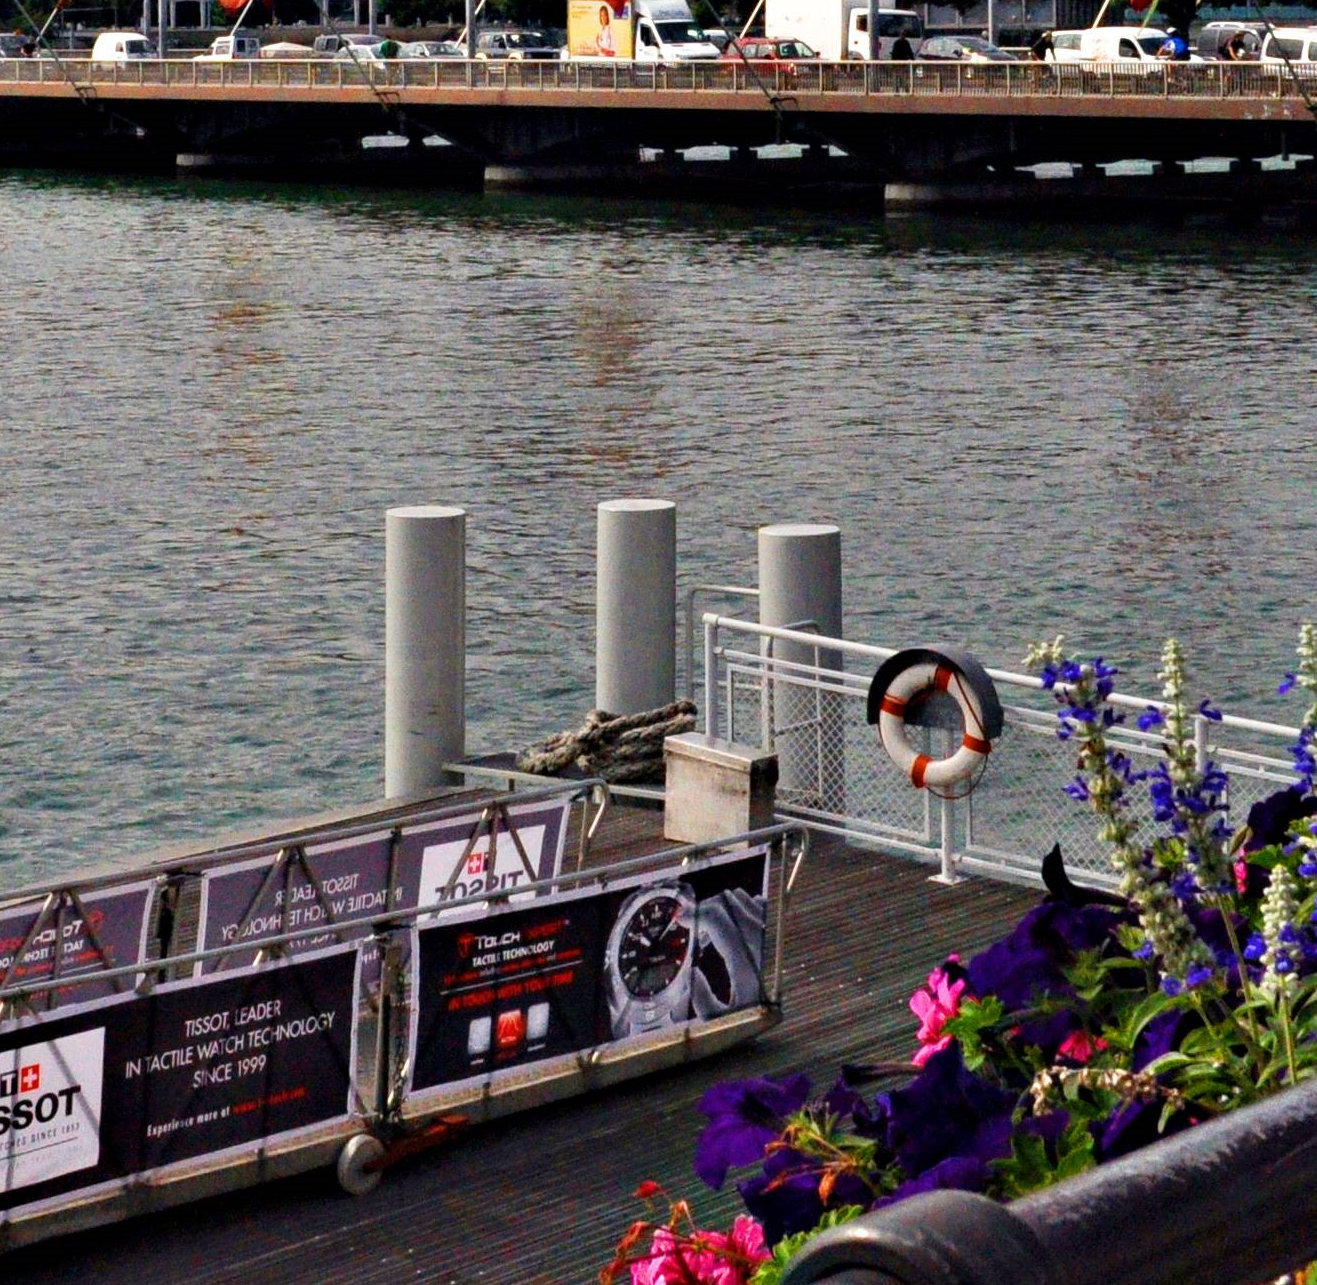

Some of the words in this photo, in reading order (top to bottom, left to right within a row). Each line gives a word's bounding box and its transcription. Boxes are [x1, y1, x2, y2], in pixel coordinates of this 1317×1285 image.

[234, 999, 282, 1026] LEADER
[124, 1058, 141, 1080] IN
[146, 1045, 194, 1074] TACTILE
[196, 1033, 245, 1061] WATCH
[248, 1010, 336, 1049] TECHNOLOGY
[192, 1062, 233, 1089] SINCE
[237, 1053, 268, 1077] 1999
[30, 1128, 58, 1144] SINCE
[146, 1117, 194, 1138] Experience
[197, 1109, 219, 1124] more
